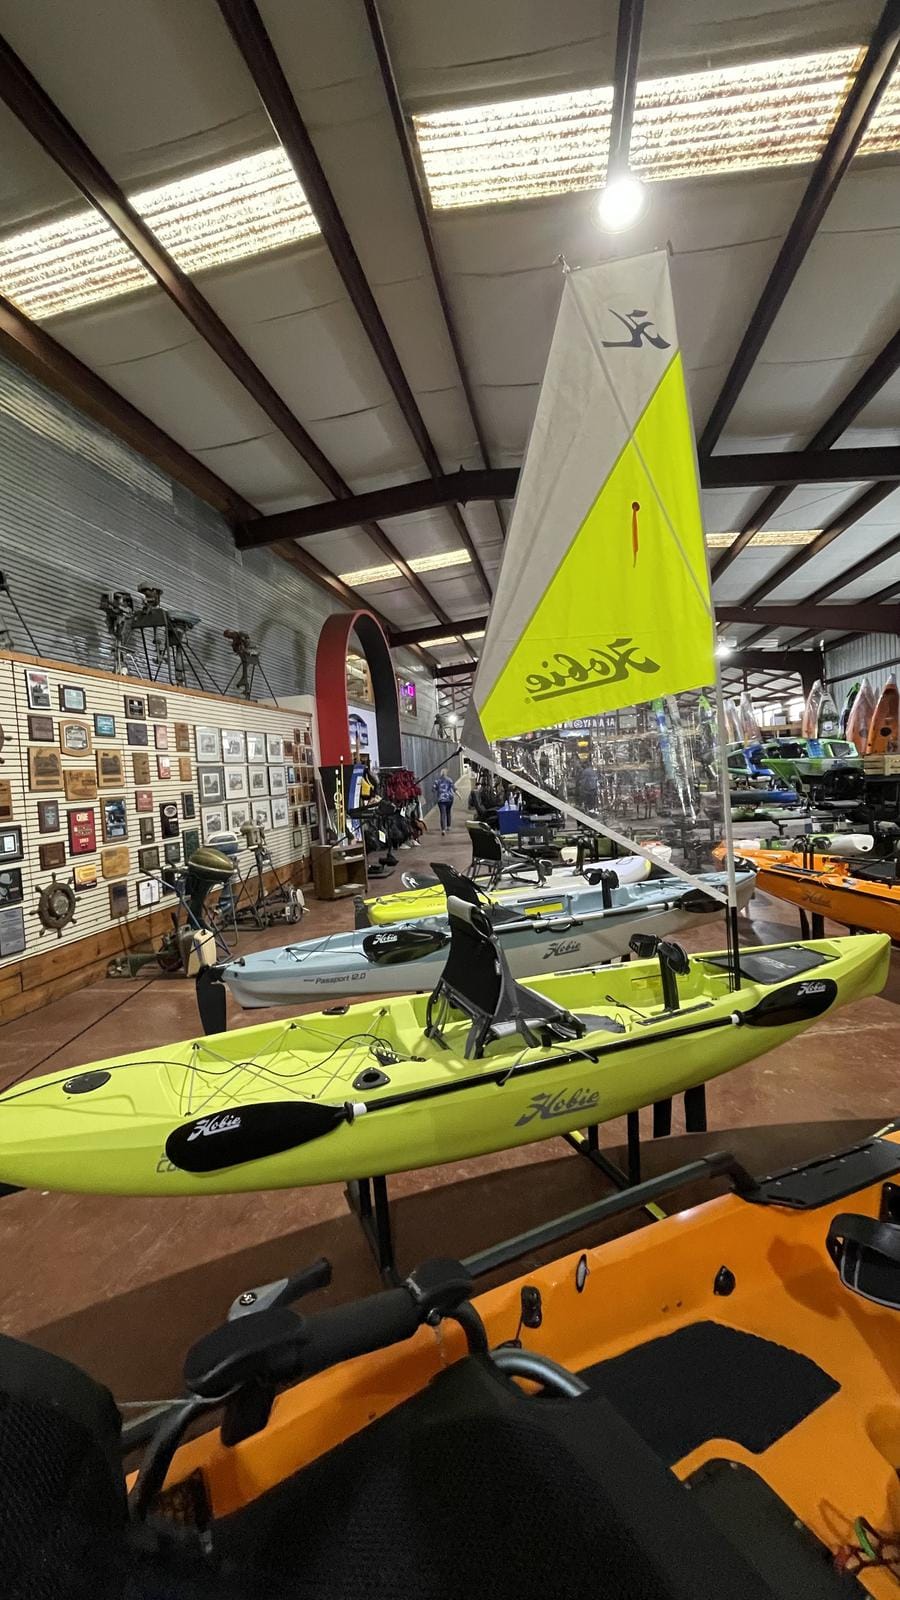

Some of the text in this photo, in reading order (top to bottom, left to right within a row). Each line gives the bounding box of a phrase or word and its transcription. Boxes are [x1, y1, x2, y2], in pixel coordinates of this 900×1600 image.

[372, 933, 398, 945] Hobie
[542, 940, 581, 960] Hobie
[315, 975, 350, 984] Passport
[797, 982, 827, 996] Hobie
[514, 1088, 600, 1127] Hobie
[186, 1115, 242, 1142] Hobie
